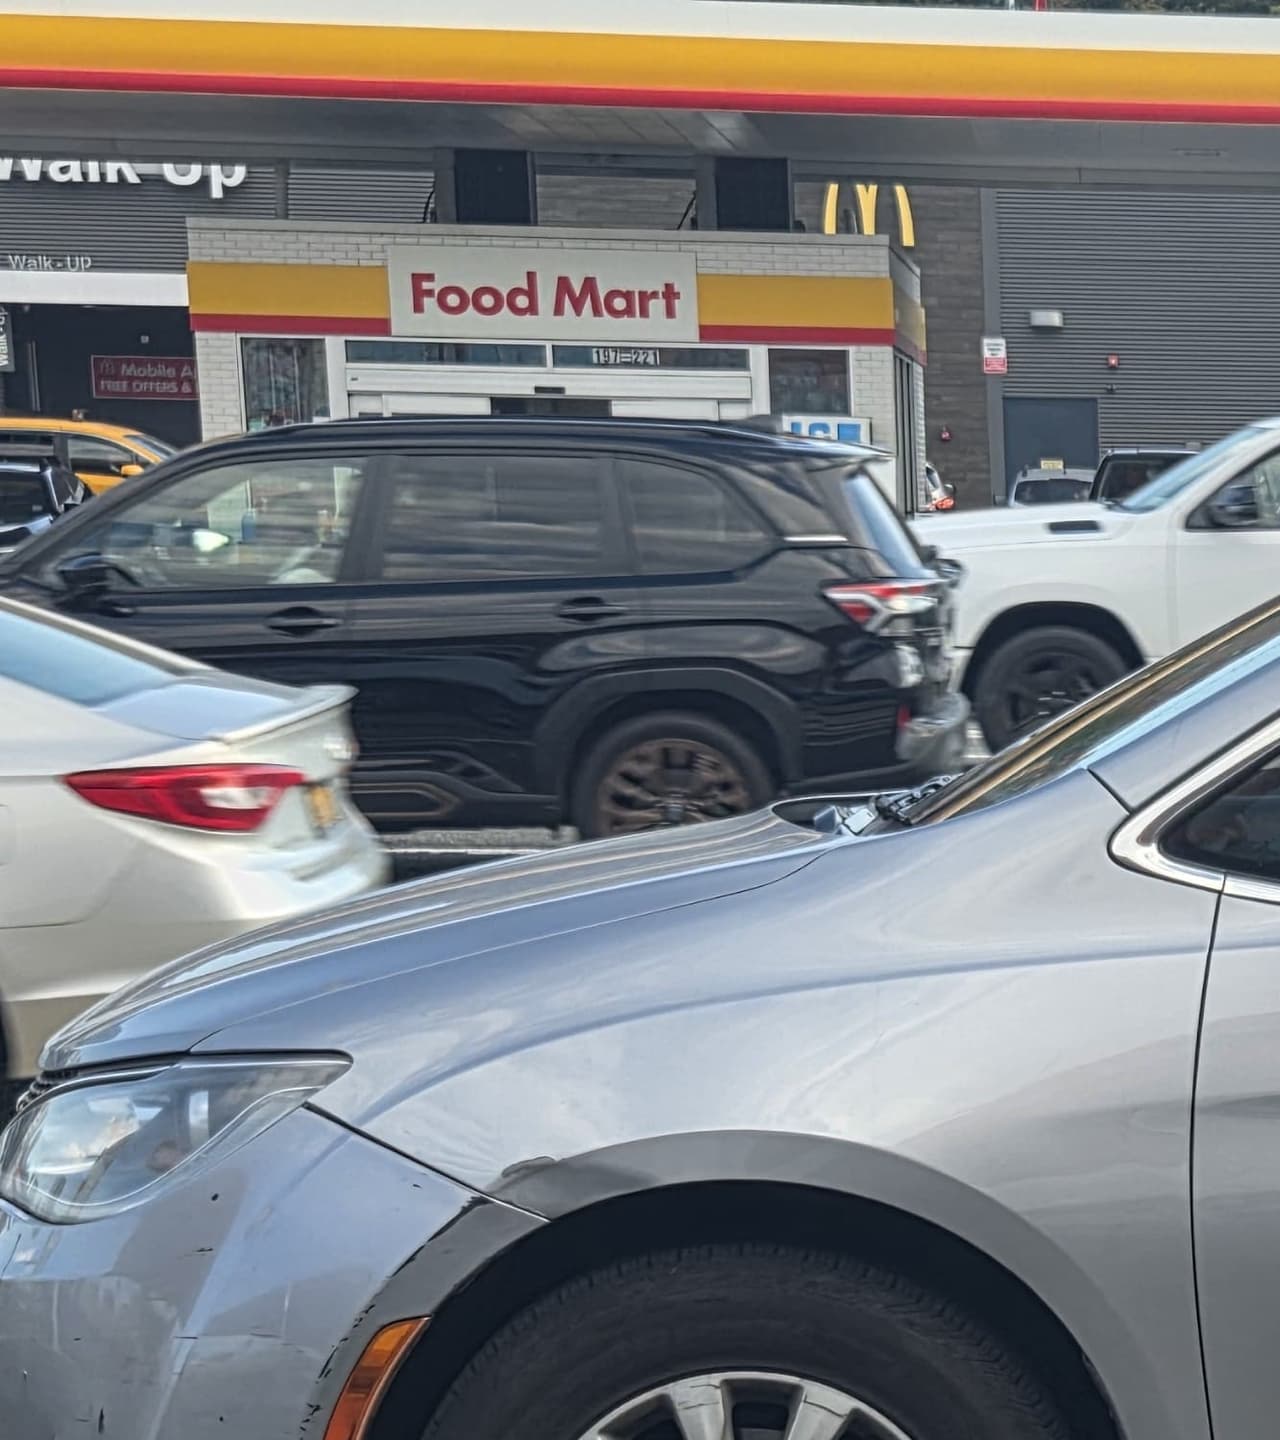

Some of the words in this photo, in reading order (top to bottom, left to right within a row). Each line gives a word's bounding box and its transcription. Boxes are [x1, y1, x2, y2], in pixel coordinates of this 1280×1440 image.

[410, 271, 539, 316] Food
[553, 276, 681, 319] Mart
[121, 363, 177, 378] Mobile
[181, 364, 197, 379] A
